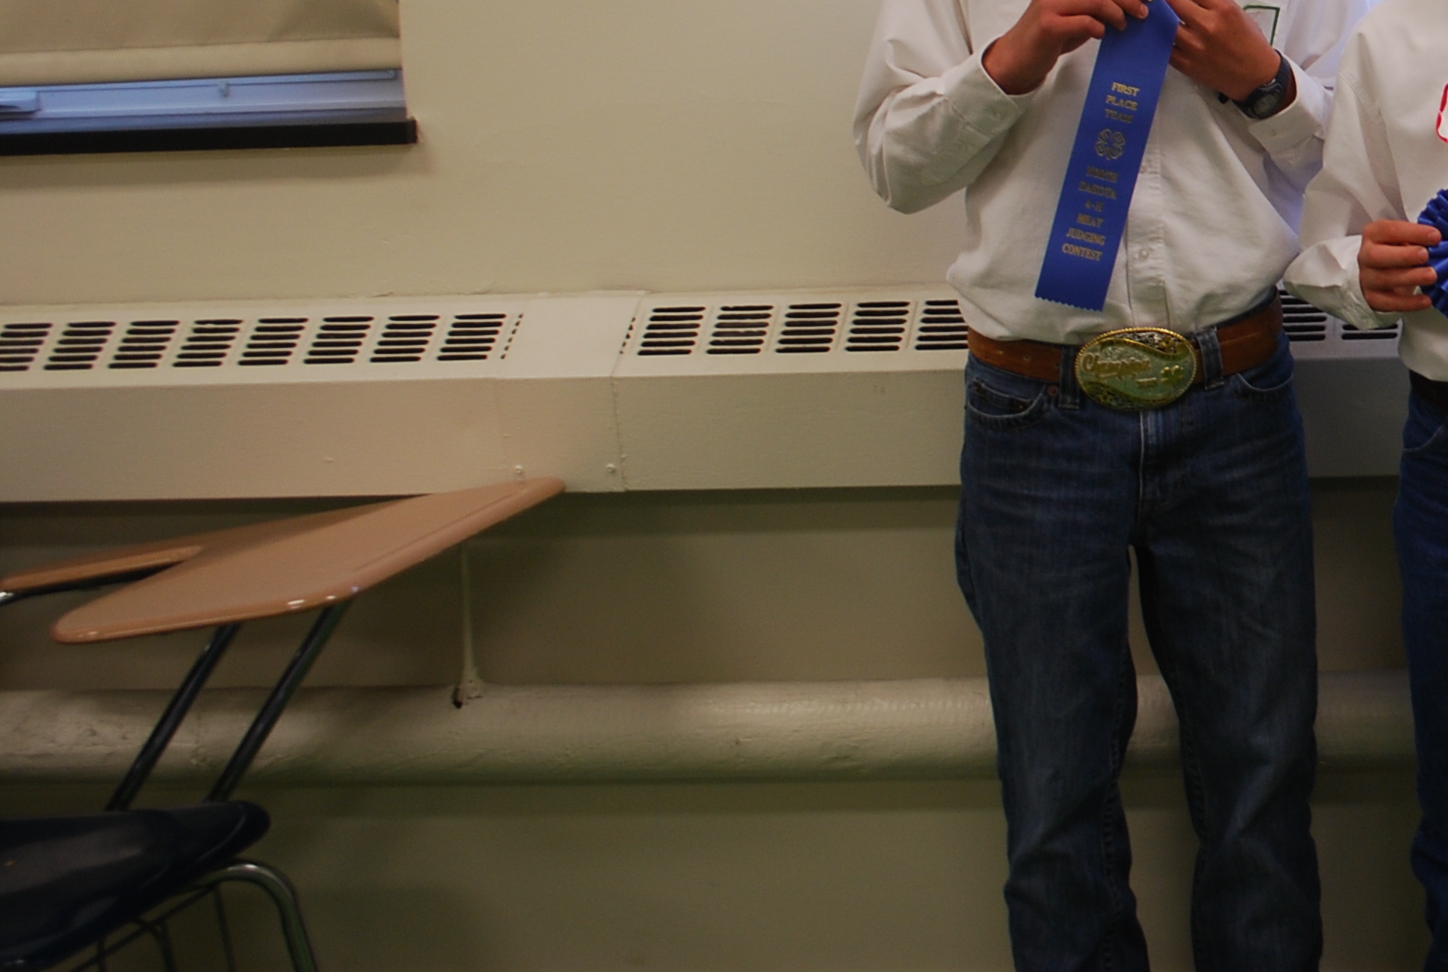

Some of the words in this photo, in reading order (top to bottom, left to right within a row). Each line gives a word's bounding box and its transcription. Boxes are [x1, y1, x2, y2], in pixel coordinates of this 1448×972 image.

[1112, 82, 1140, 96] FIRST
[1106, 95, 1138, 110] PLACE
[1105, 109, 1133, 123] TEAM
[1066, 228, 1106, 245] JUDGING
[1062, 243, 1102, 261] CONTEST
